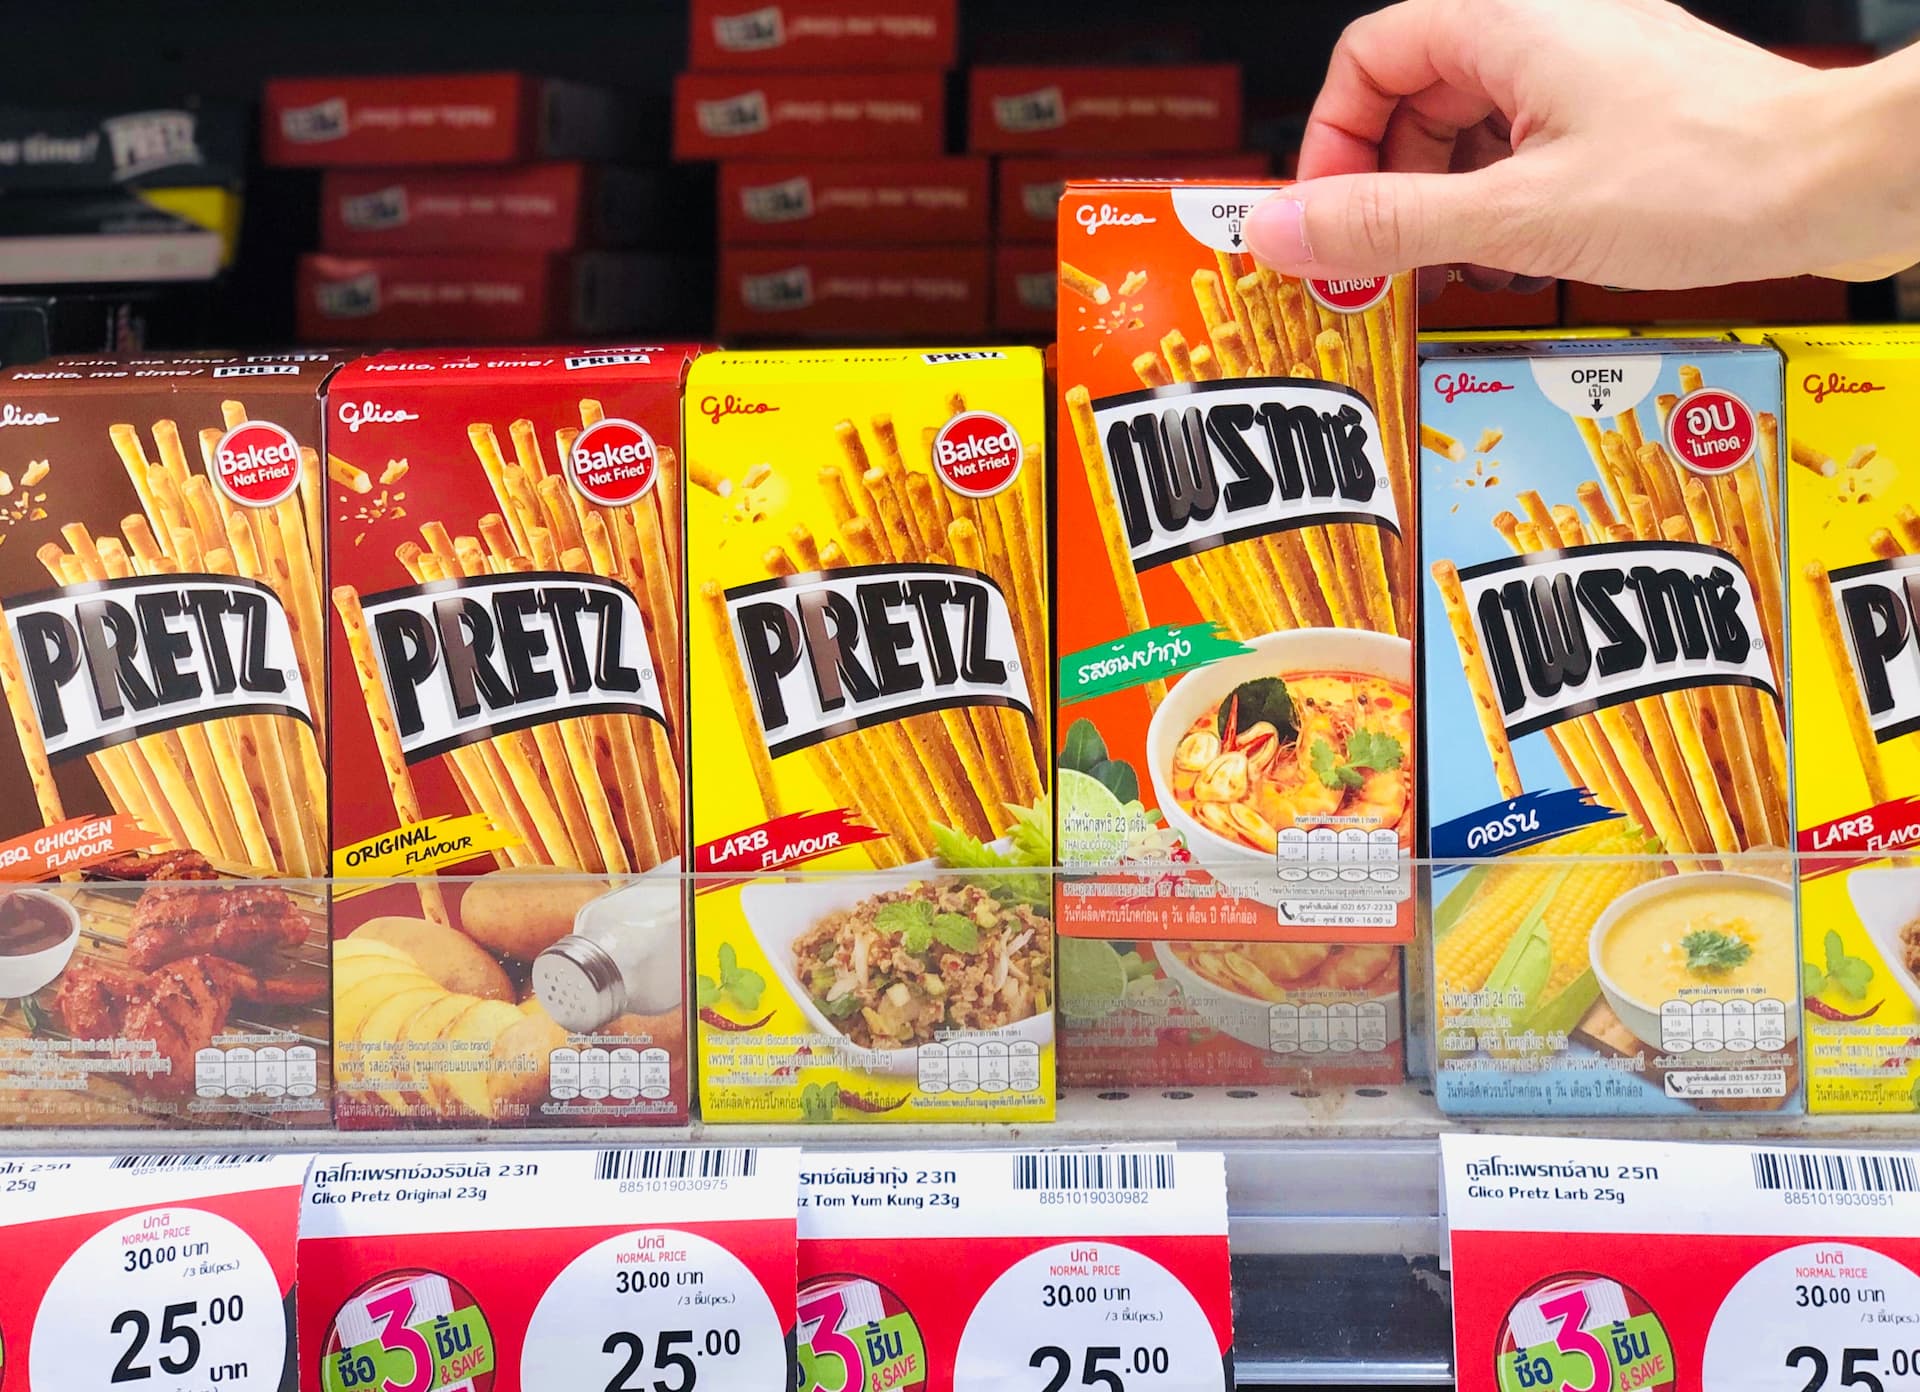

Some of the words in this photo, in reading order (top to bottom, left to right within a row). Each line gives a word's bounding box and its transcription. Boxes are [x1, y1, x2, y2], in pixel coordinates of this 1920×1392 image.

[1075, 204, 1156, 235] Glico
[1211, 204, 1255, 219] OPE
[364, 362, 436, 373] Hello,
[440, 361, 480, 370] me
[485, 358, 554, 369] time!
[568, 355, 646, 368] PRETZ
[923, 351, 1004, 364] PRETZ
[1434, 373, 1515, 403] Glico
[1570, 367, 1624, 385] OPEN
[1803, 373, 1885, 403] Glico
[1588, 383, 1611, 400] เปิด
[0, 403, 60, 426] lico
[338, 400, 420, 432] Glico
[700, 394, 780, 424] Glico
[1687, 401, 1737, 433] อบ
[220, 437, 295, 476] Baked
[573, 437, 652, 475] Baked
[936, 427, 1018, 467] Baked
[232, 469, 258, 488] Not
[257, 463, 290, 484] Fried
[587, 469, 613, 488] Not
[613, 462, 646, 481] Fried
[952, 460, 978, 479] Not
[978, 454, 1011, 474] Fried
[15, 588, 287, 740] PRETZ
[374, 586, 642, 738] PRETZ
[736, 578, 1008, 732] PRETZ
[1077, 629, 1192, 685] รสต้มยำกุ้ง
[34, 820, 113, 854] CHICKEN
[1115, 817, 1126, 833] 23
[1467, 800, 1540, 850] คอร์น
[1811, 814, 1875, 850] LARB
[45, 839, 115, 870] FLAVOUR
[345, 826, 437, 868] ORIGINAL
[405, 836, 473, 865] FLAVOUR
[709, 829, 769, 864] LARB
[761, 832, 841, 868] FLAVOUR
[1492, 991, 1504, 1008] 24
[498, 1163, 539, 1177] 23ก
[915, 1170, 956, 1185] 23ก
[1617, 1165, 1659, 1180] 25ก
[6, 1178, 37, 1193] 25g
[311, 1191, 347, 1205] Glico
[350, 1190, 391, 1204] Pretz
[395, 1187, 453, 1204] Original
[456, 1186, 488, 1202] 23g
[618, 1178, 729, 1195] 8851019030975
[1467, 1185, 1505, 1199] Glico
[1508, 1186, 1550, 1200] Pretz
[1554, 1186, 1589, 1201] Larb
[1593, 1188, 1626, 1204] 25g
[813, 1193, 846, 1208] Tom
[850, 1193, 883, 1208] Yum
[887, 1193, 924, 1210] Kung
[928, 1193, 960, 1209] 23g
[1038, 1191, 1150, 1206] 8851019030982
[1783, 1192, 1895, 1206] 8851019030951
[142, 1212, 172, 1230] ปกติ
[121, 1231, 161, 1246] NORMAL
[162, 1225, 191, 1240] PRICE
[636, 1234, 666, 1251] ปกติ
[123, 1246, 177, 1273] 30.00
[183, 1241, 210, 1258] บาท
[616, 1251, 656, 1264] NORMAL
[658, 1250, 687, 1263] PRICE
[1069, 1247, 1099, 1264] ปกติ
[1814, 1250, 1845, 1266] ปกติ
[615, 1270, 671, 1294] 30.00
[676, 1269, 704, 1286] บาท
[1049, 1264, 1090, 1277] NORMAL
[1092, 1264, 1120, 1277] PRICE
[1795, 1266, 1837, 1279] NORMAL
[1839, 1267, 1868, 1279] PRICE
[1041, 1284, 1097, 1307] 30.00
[1103, 1286, 1131, 1302] บาท
[1795, 1284, 1851, 1308] 30.00
[1857, 1288, 1886, 1304] บาท
[110, 1294, 244, 1384] 25.00
[209, 1361, 249, 1383] บาท
[337, 1347, 376, 1388] ซื้อ
[365, 1286, 434, 1392] 3
[434, 1315, 473, 1360] ชิ้น
[865, 1321, 904, 1366] ชิ้น
[1512, 1347, 1554, 1389] ซื้อ
[1538, 1289, 1614, 1392] 3
[1611, 1319, 1652, 1367] ชิ้น
[440, 1364, 452, 1385] &
[450, 1345, 486, 1380] SAVE
[871, 1371, 883, 1392] &
[882, 1353, 917, 1388] SAVE
[1619, 1370, 1631, 1392] &
[1630, 1353, 1666, 1387] SAVE
